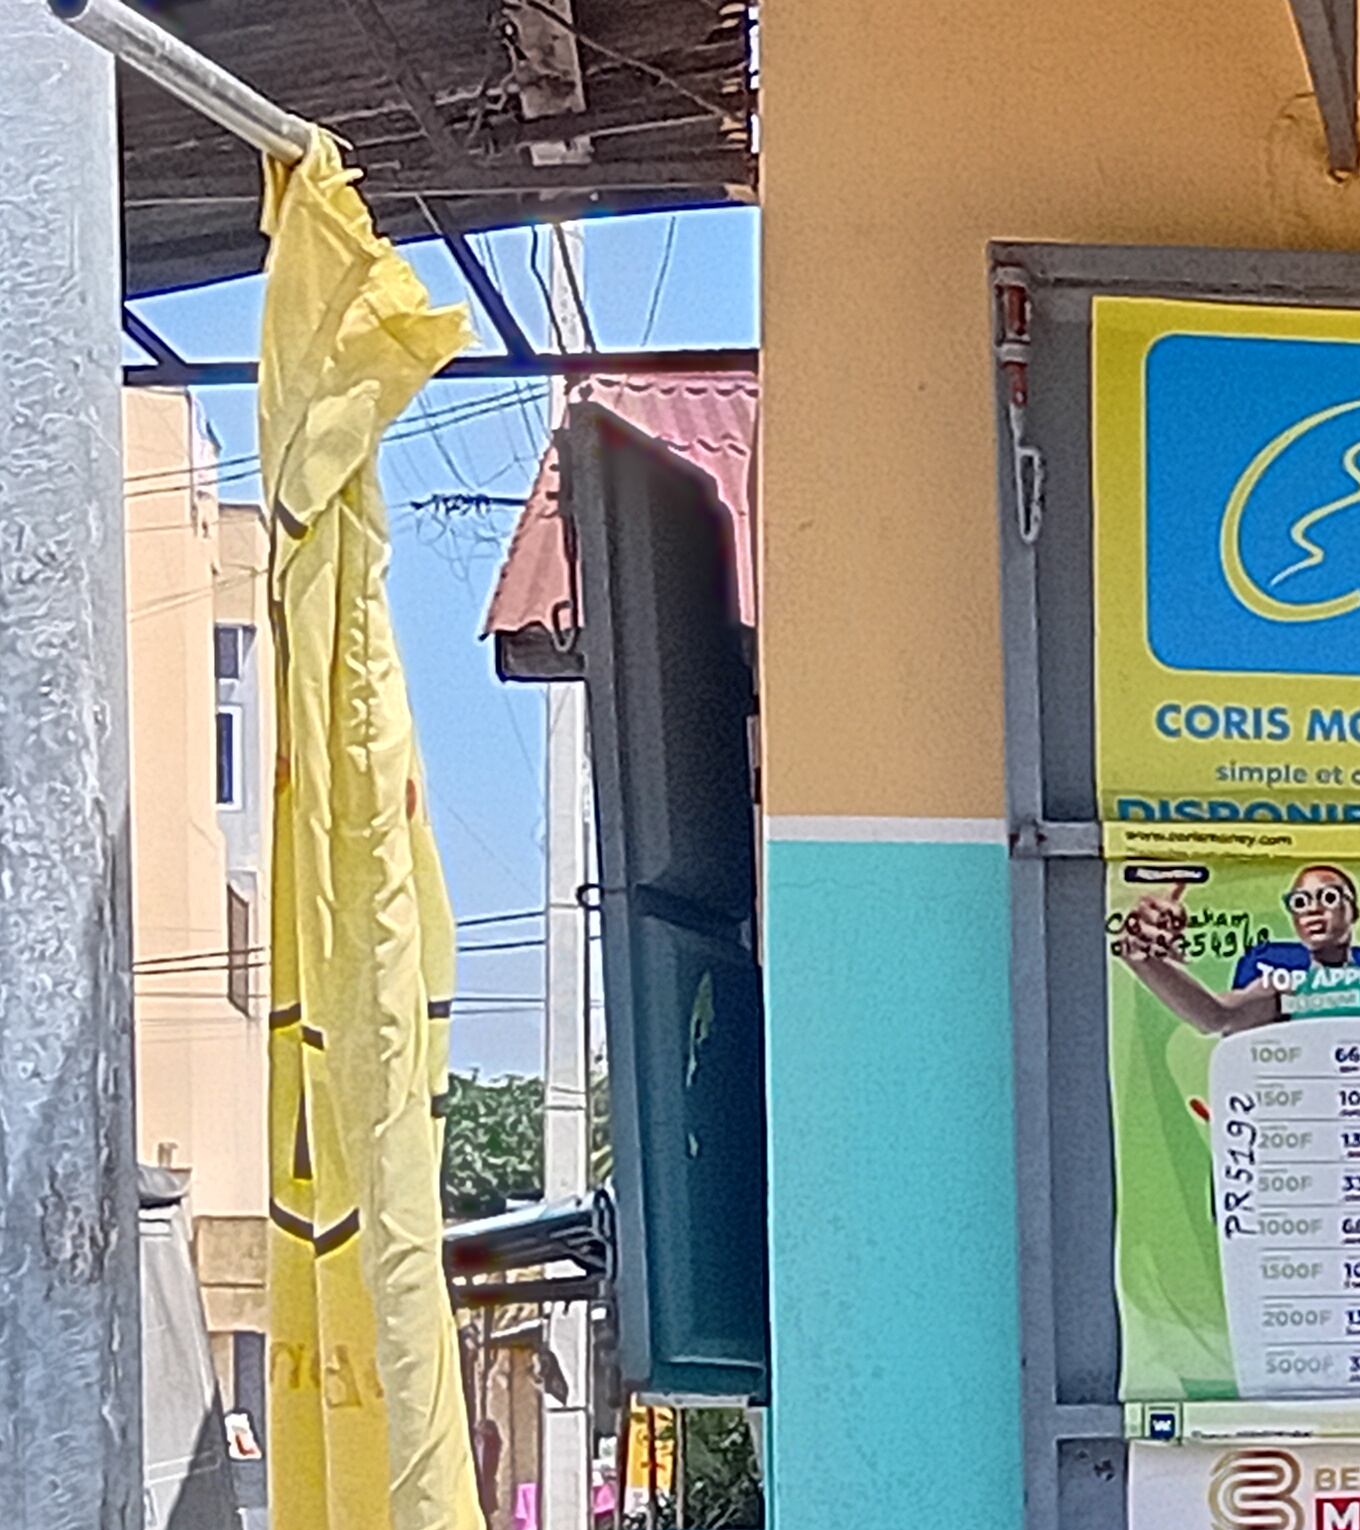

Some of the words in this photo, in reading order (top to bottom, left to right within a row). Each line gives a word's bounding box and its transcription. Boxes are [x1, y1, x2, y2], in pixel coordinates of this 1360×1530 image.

[1155, 702, 1291, 742] CORIS
[1215, 761, 1308, 789] simple
[1316, 765, 1343, 785] et
[1256, 961, 1307, 991] TOP
[1257, 1132, 1313, 1149] 200F
[1257, 1175, 1313, 1193] 500F
[1260, 1261, 1324, 1280] 1500F
[1261, 1309, 1333, 1328] 2000F
